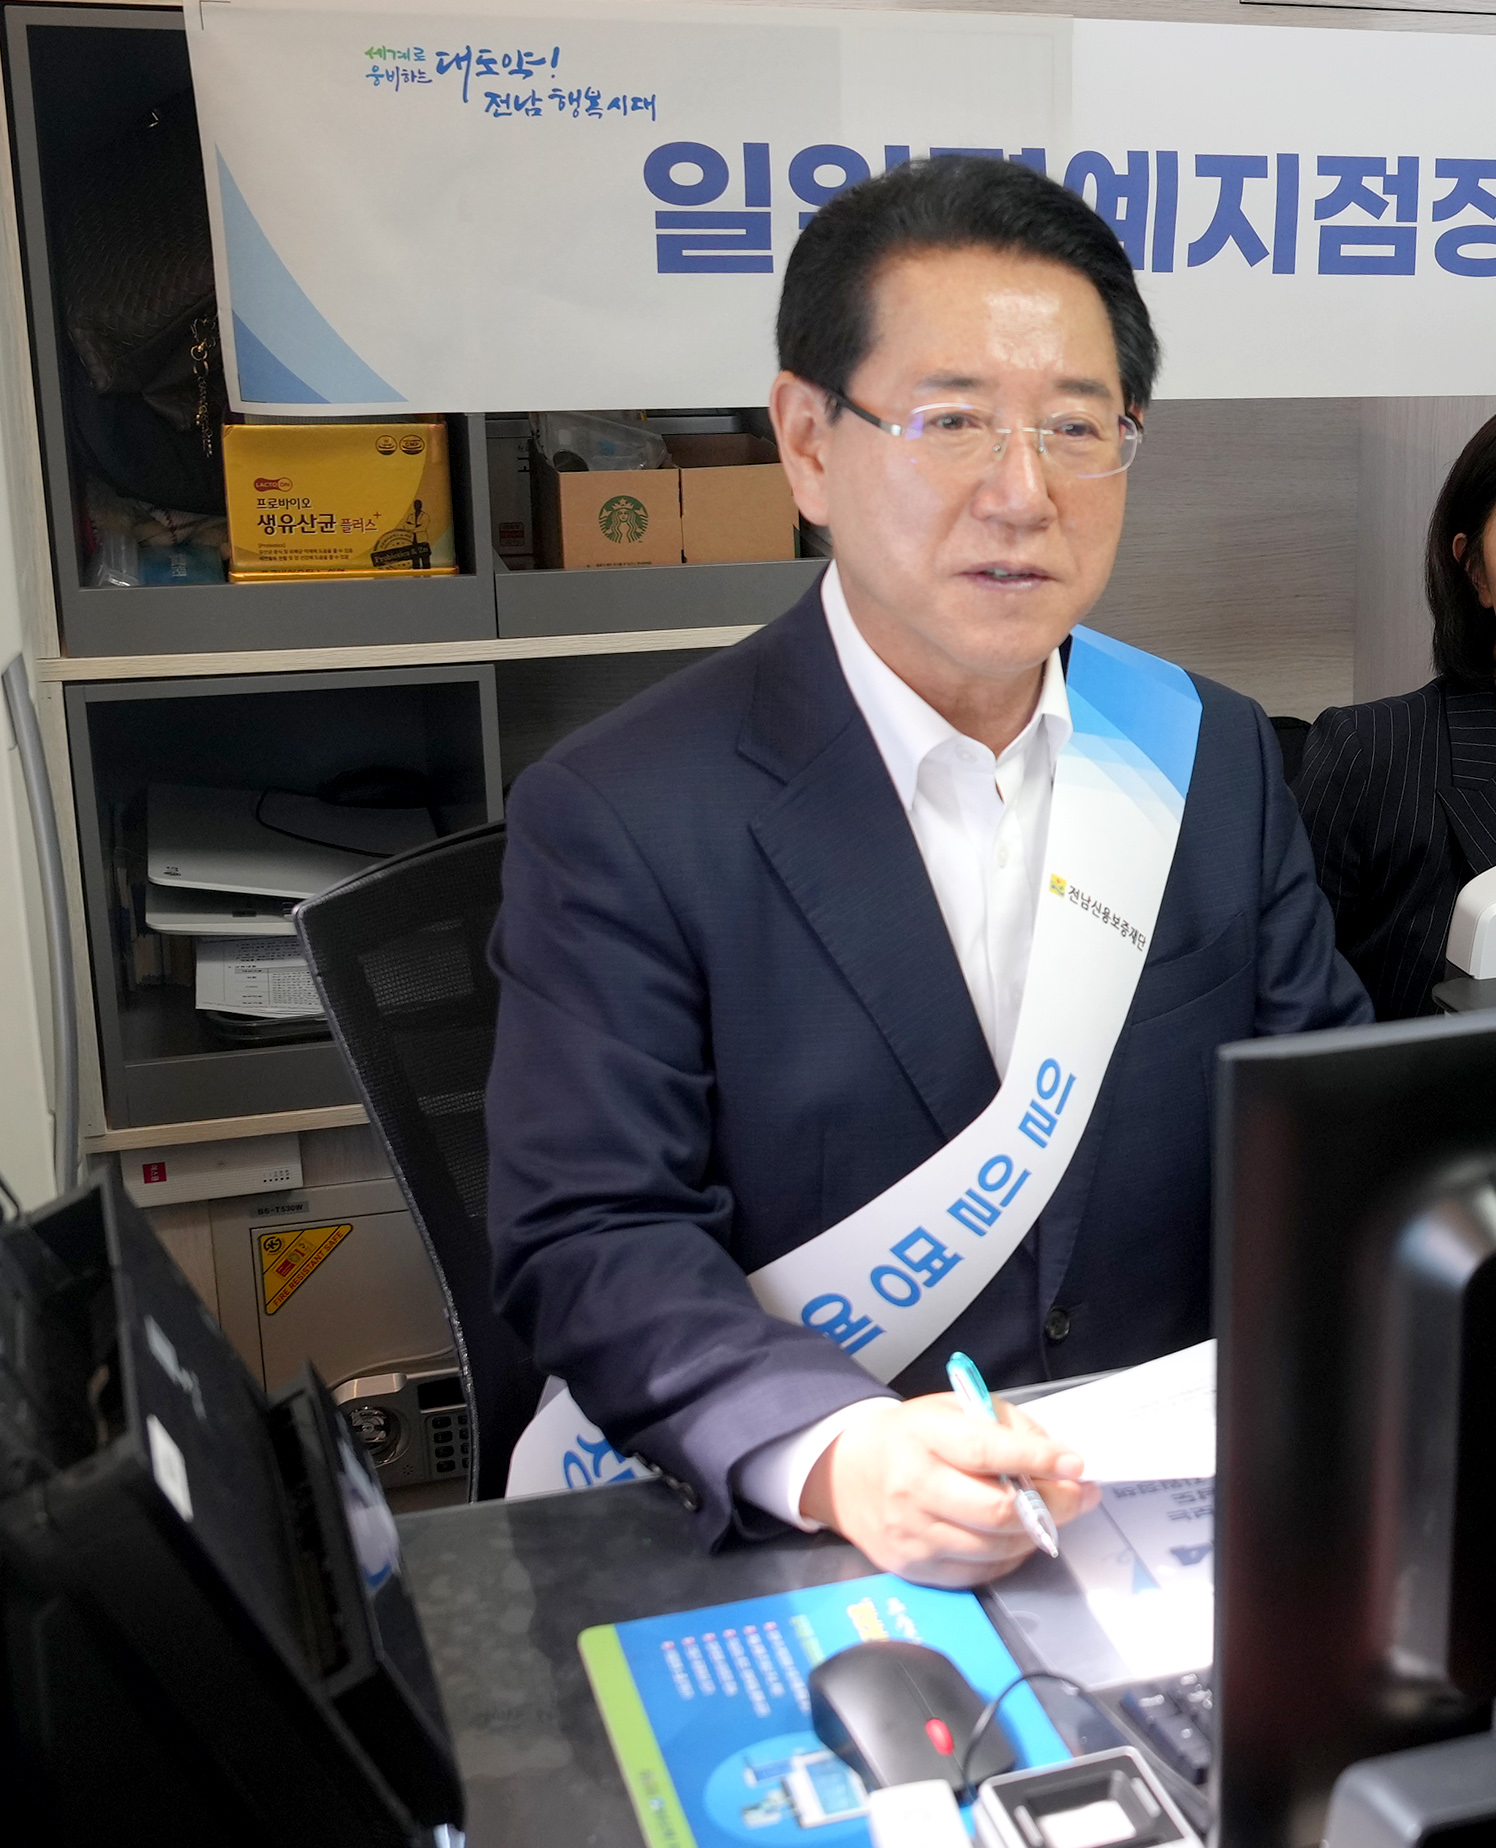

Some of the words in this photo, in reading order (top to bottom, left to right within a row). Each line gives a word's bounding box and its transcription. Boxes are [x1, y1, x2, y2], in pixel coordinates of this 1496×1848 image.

[365, 65, 433, 92] 웅비하는
[435, 45, 560, 103] 대도약!
[484, 90, 543, 117] 전남
[547, 86, 603, 119] 행복
[606, 94, 656, 121] 시대
[256, 497, 312, 511] 프로바이오
[257, 513, 338, 536] 생유산균
[1067, 884, 1147, 952] 전남신용보증재단
[273, 1288, 290, 1307] FIRE
[288, 1250, 325, 1290] RESISTANT
[324, 1231, 344, 1252] SAFE
